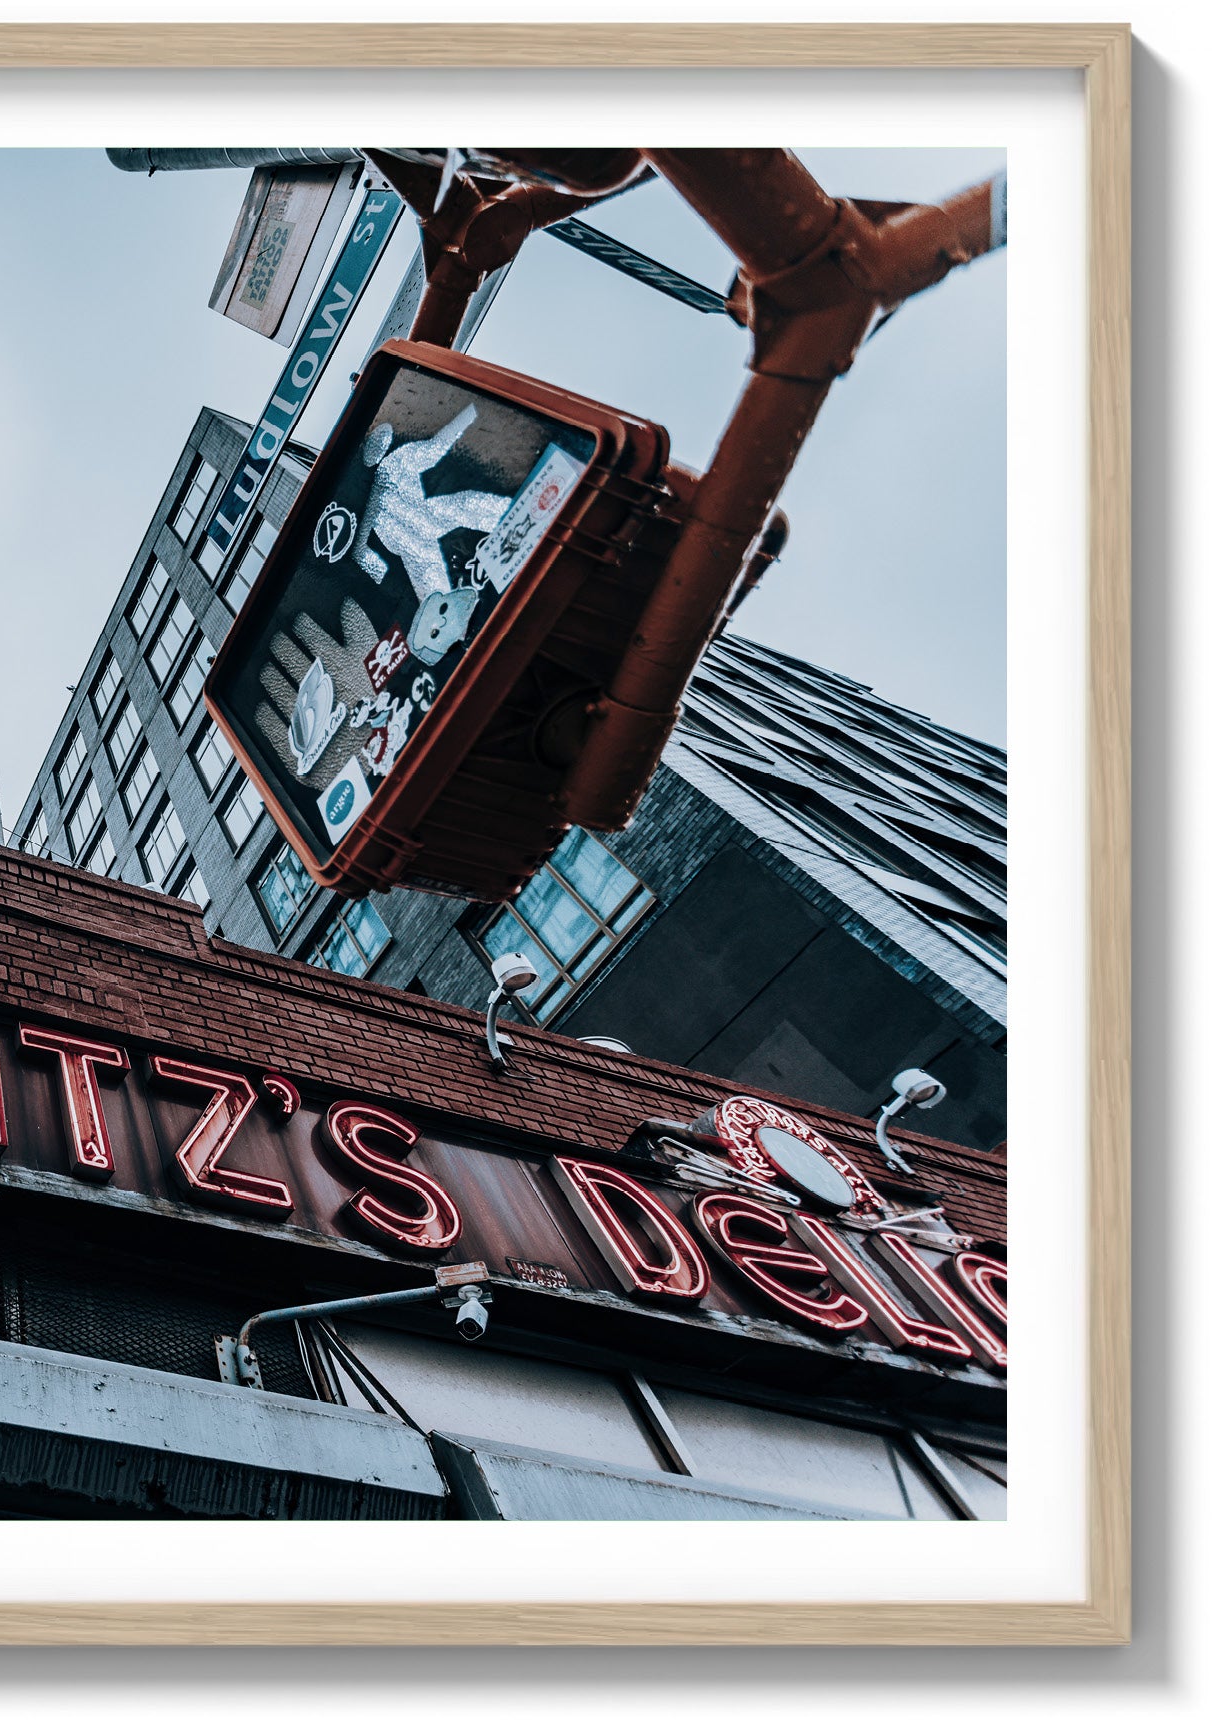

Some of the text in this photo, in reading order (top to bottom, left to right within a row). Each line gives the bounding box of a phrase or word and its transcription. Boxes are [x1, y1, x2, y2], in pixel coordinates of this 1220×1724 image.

[249, 226, 283, 301] TATTOO
[258, 228, 289, 304] SHOP
[215, 193, 389, 539] Ludlow St
[385, 647, 409, 675] PAULI
[329, 783, 352, 821] argue
